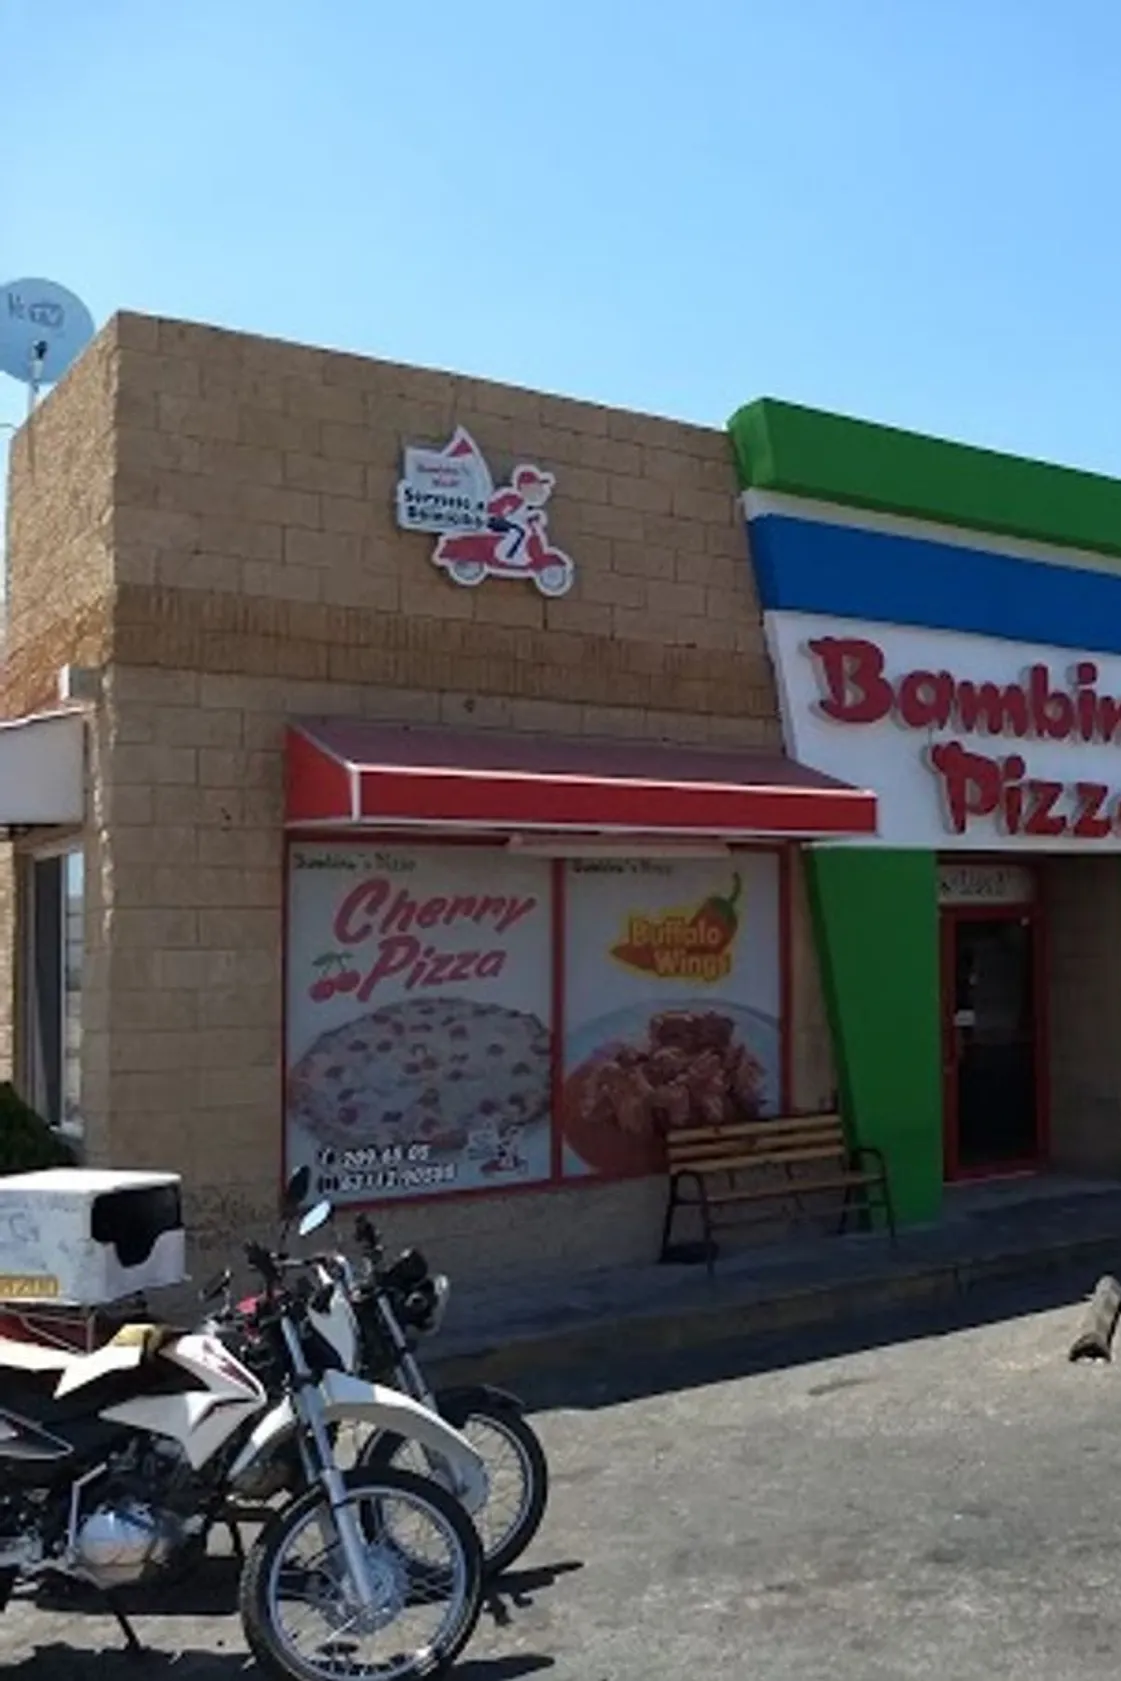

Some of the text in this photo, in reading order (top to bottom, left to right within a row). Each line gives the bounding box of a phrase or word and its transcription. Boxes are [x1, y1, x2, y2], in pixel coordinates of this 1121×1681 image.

[333, 877, 538, 945] Cherry
[628, 915, 724, 947] Buffalo
[356, 934, 507, 1003] Pizza
